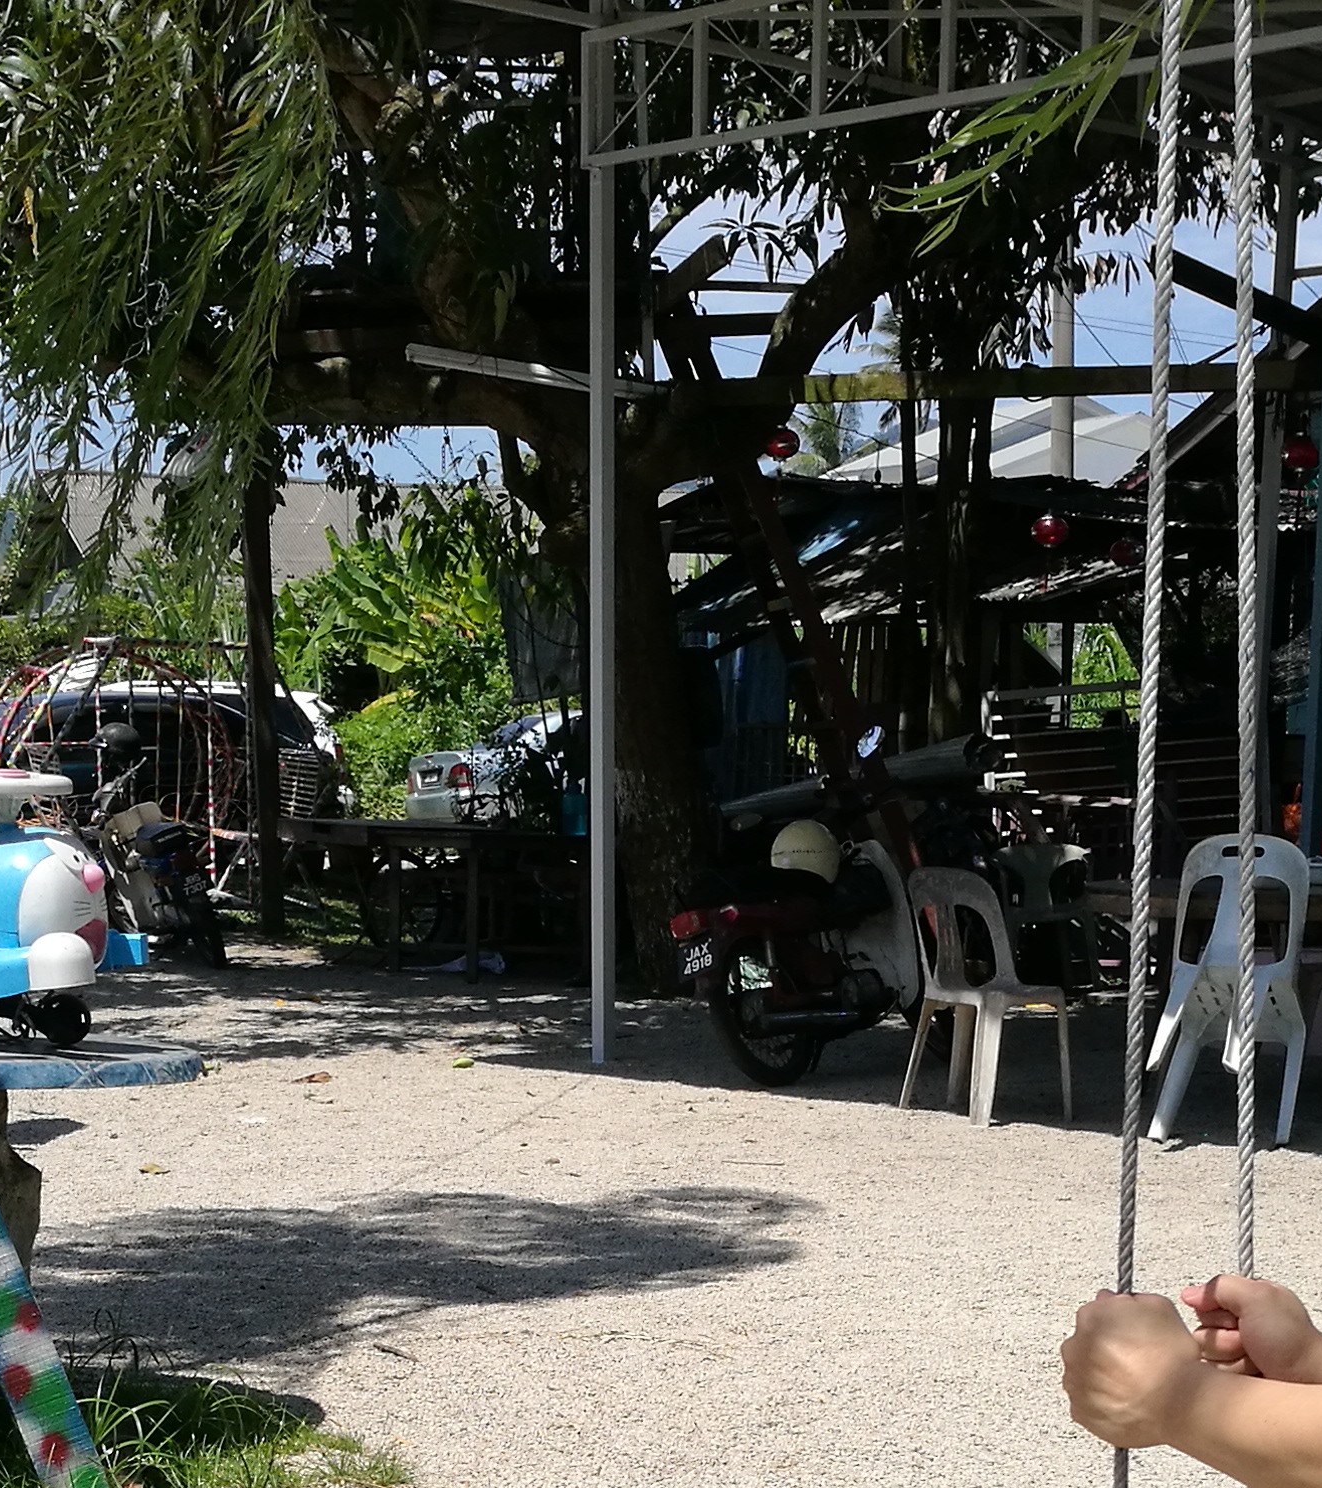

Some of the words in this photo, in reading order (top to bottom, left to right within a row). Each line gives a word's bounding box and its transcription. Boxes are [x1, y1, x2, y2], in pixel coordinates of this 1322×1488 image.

[183, 880, 207, 896] 7307
[686, 942, 709, 961] JAX
[684, 954, 712, 974] 4918
